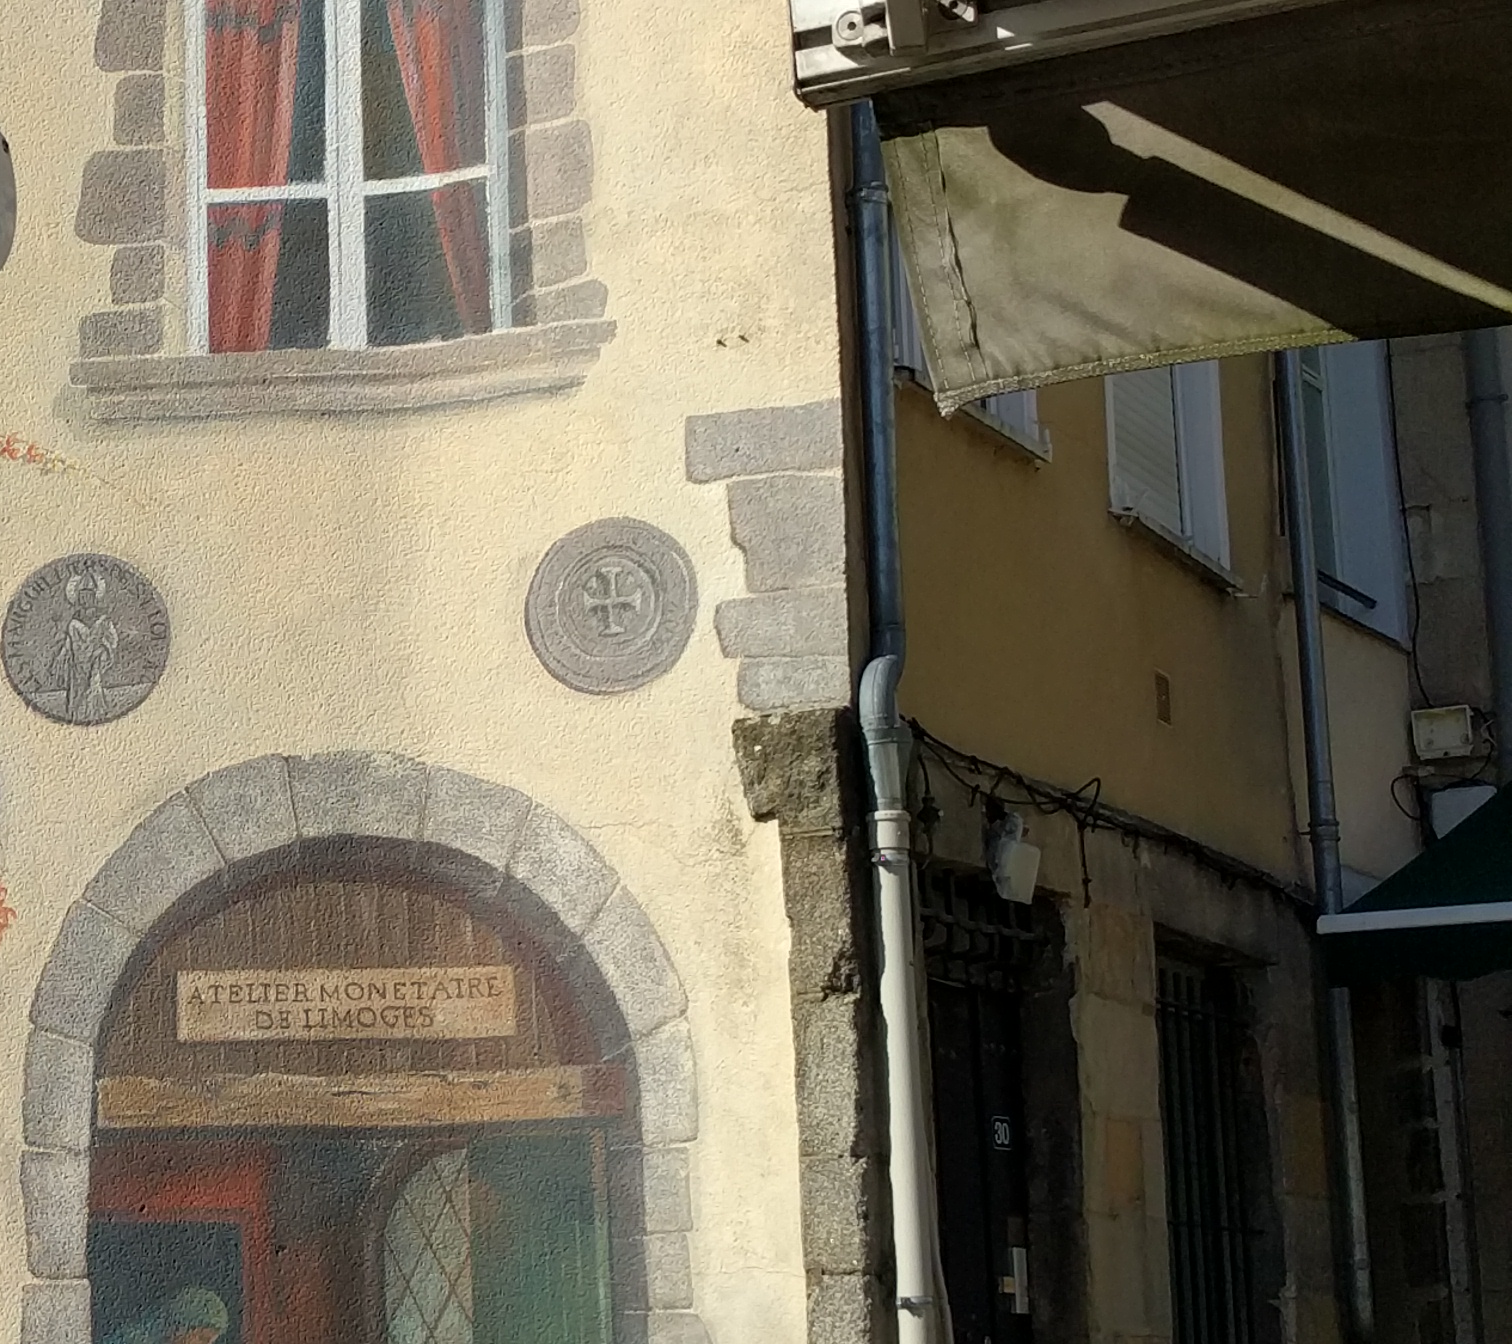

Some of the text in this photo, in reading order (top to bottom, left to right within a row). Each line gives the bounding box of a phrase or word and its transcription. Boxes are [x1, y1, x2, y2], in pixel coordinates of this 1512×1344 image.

[189, 977, 505, 1006] ATELIER MONETAIRE
[255, 1006, 435, 1030] DE LIMOGES
[994, 1121, 1010, 1144] 30
